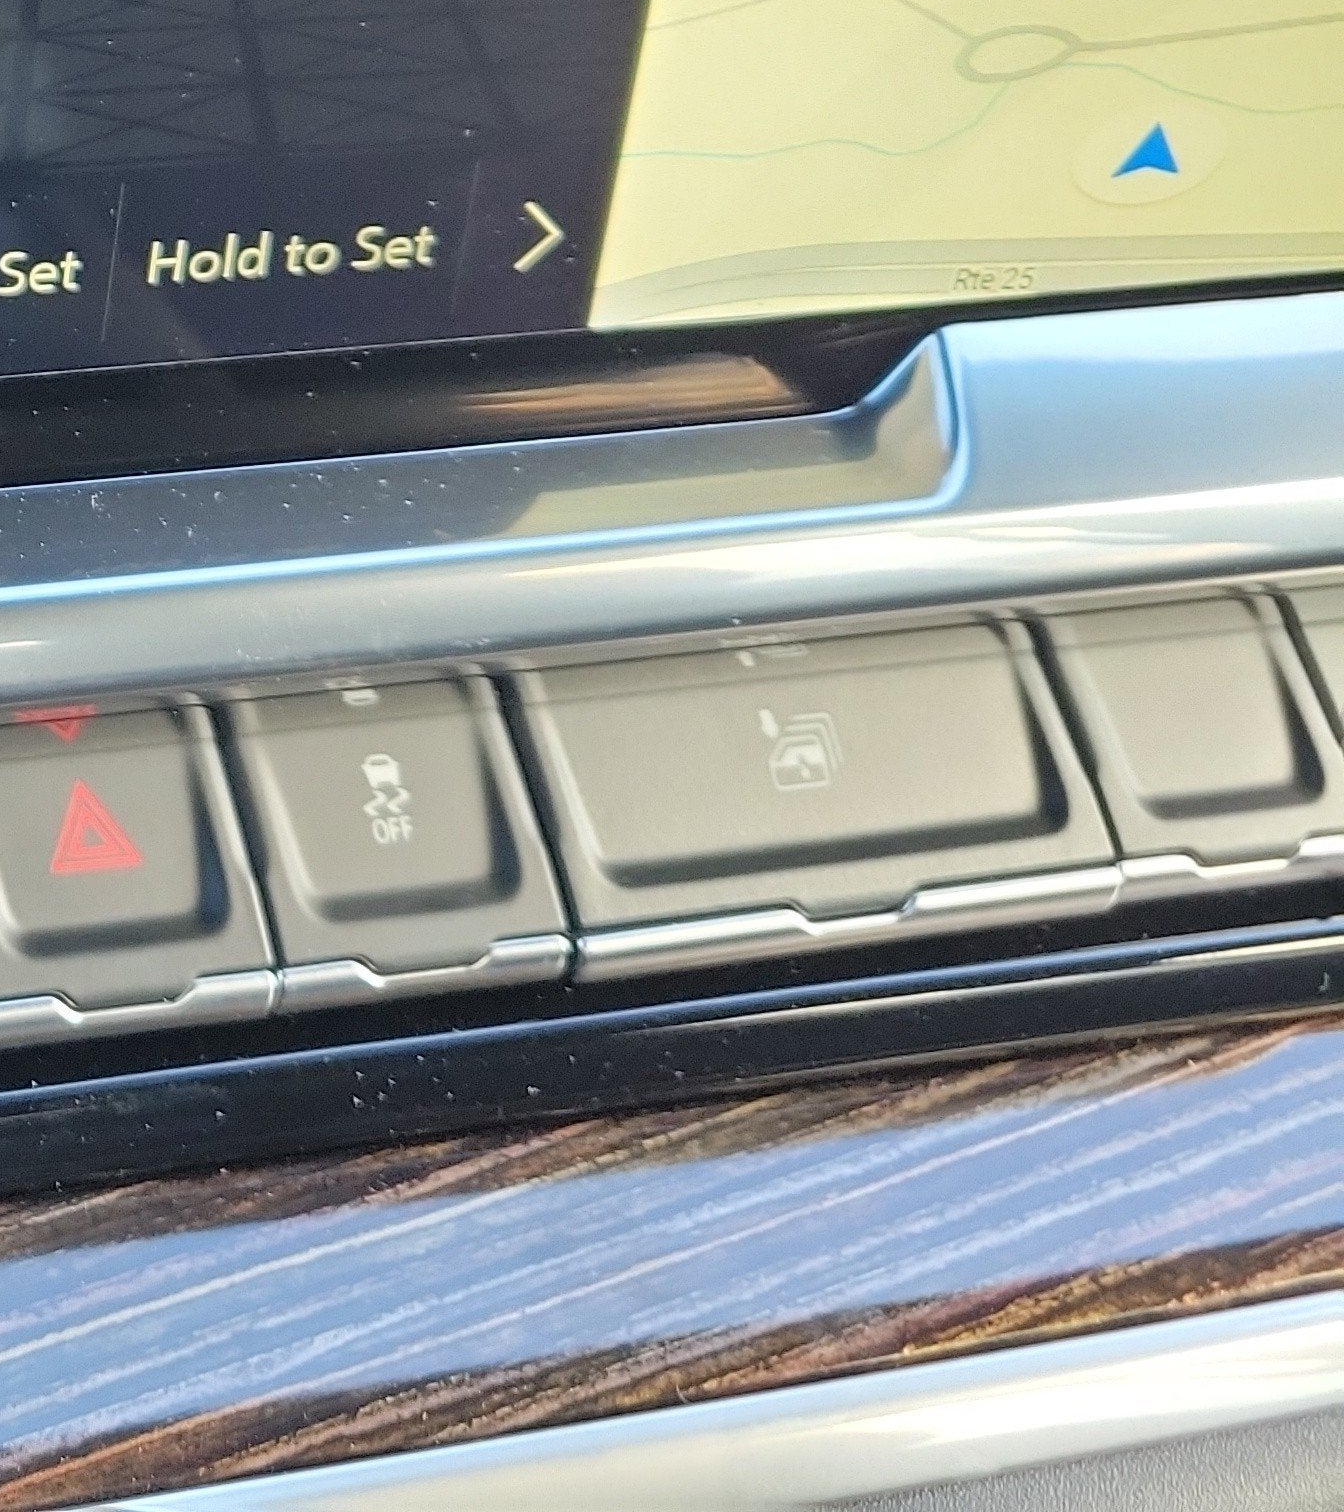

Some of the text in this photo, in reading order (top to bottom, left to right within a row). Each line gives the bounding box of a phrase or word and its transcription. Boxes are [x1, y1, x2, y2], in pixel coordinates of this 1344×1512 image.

[145, 224, 438, 287] Hold to Set
[953, 266, 1036, 291] Rte 25
[371, 815, 414, 844] OFF
